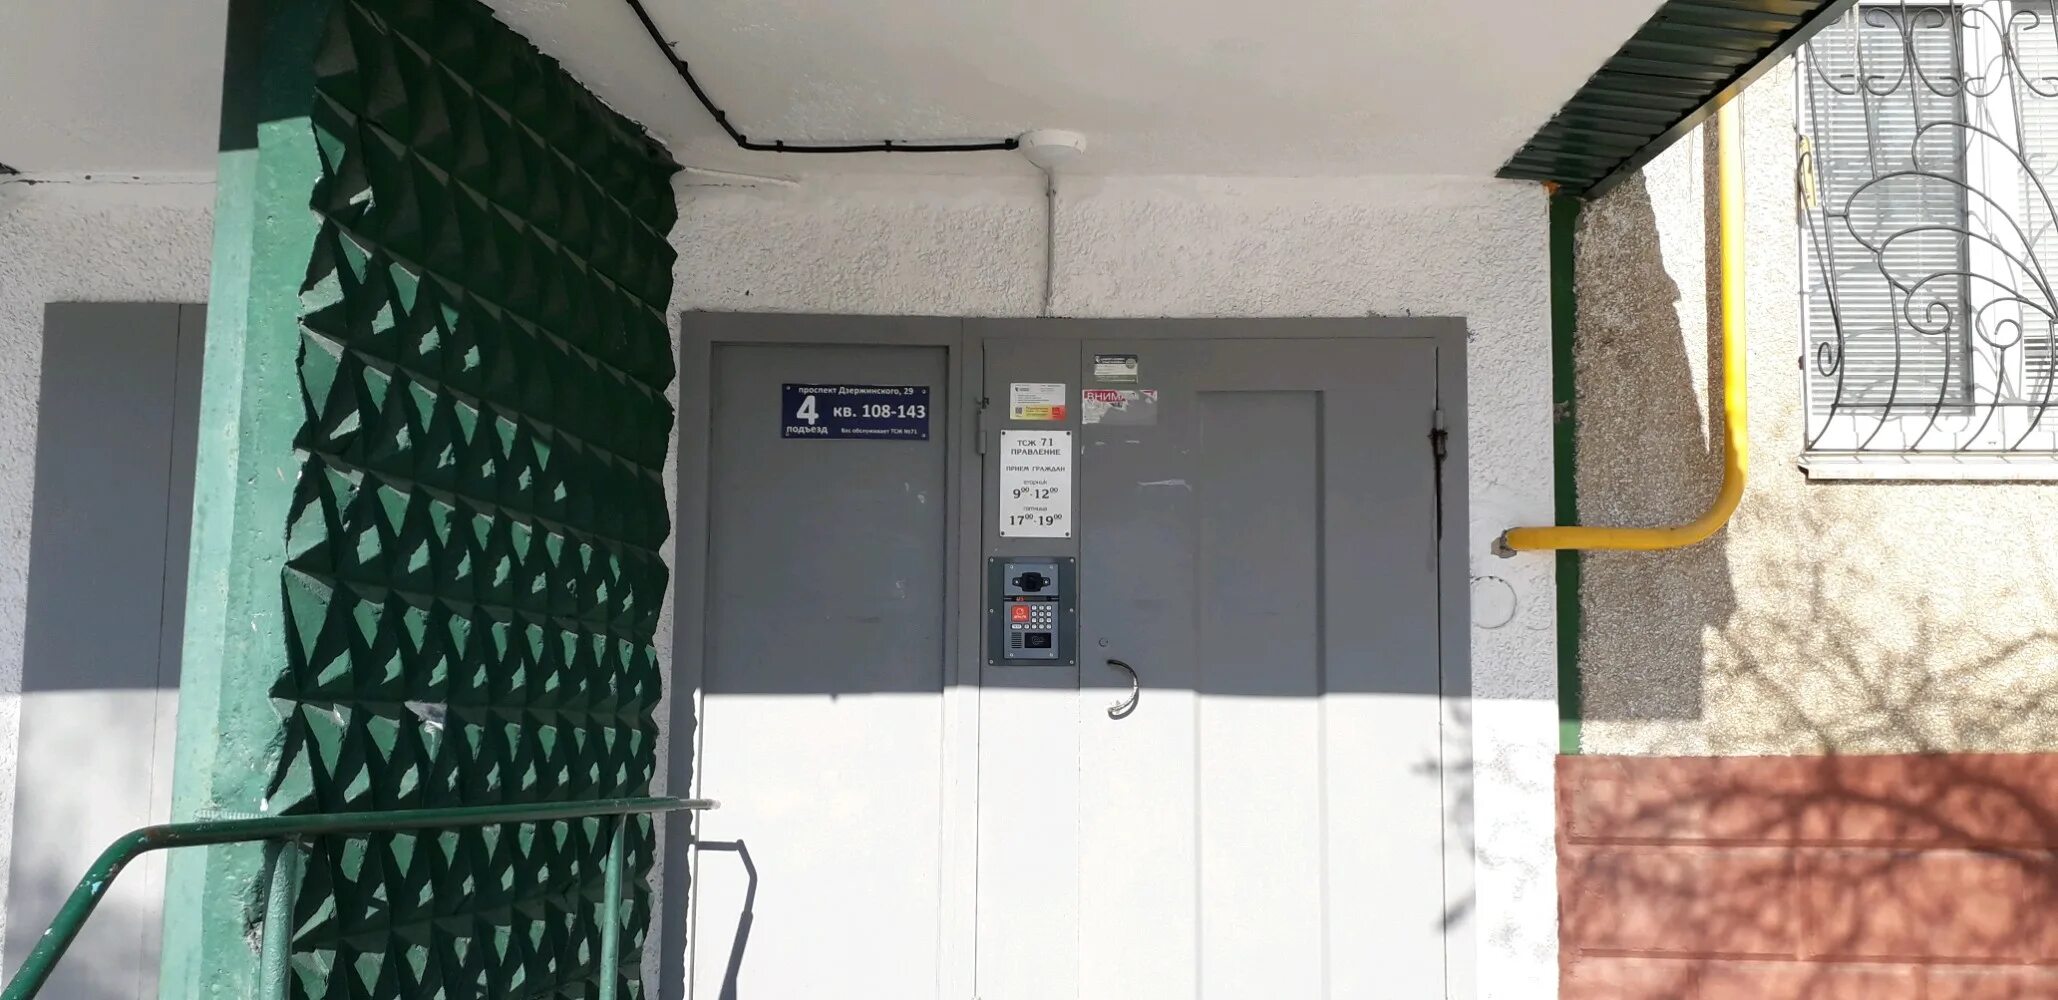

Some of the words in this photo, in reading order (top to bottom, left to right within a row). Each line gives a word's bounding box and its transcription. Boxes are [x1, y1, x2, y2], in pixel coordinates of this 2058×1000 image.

[838, 386, 901, 395] Дзержинского,
[903, 387, 914, 395] 29
[796, 395, 819, 425] 4
[833, 407, 857, 417] кв.
[862, 404, 926, 418] 108-143
[786, 426, 828, 434] подъезд
[1041, 438, 1053, 446] 71
